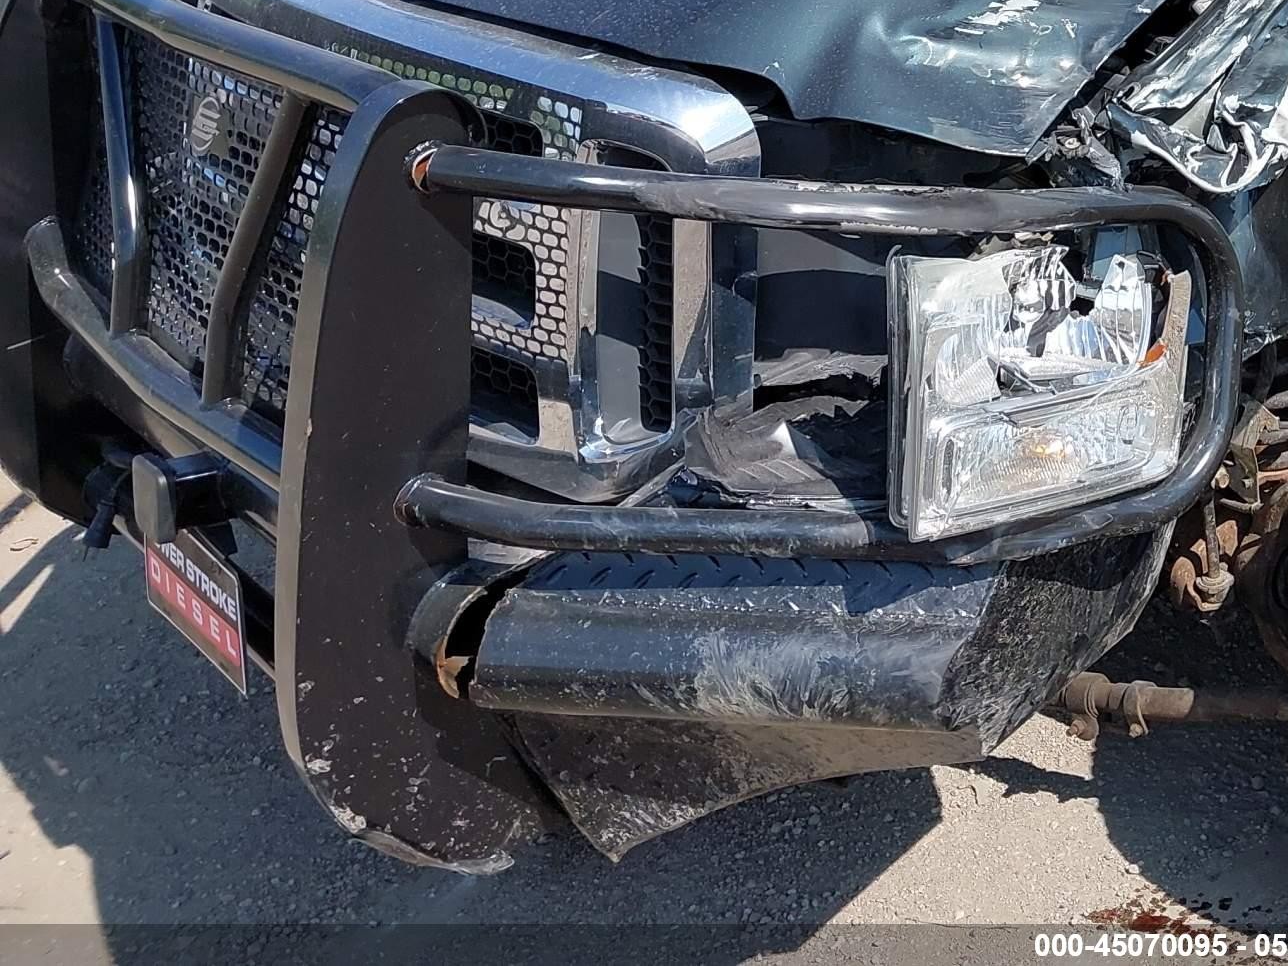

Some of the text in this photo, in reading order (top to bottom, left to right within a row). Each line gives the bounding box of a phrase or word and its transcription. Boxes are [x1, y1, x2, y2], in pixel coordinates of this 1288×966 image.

[151, 556, 237, 659] DIESEL
[155, 542, 236, 621] WER STROKE
